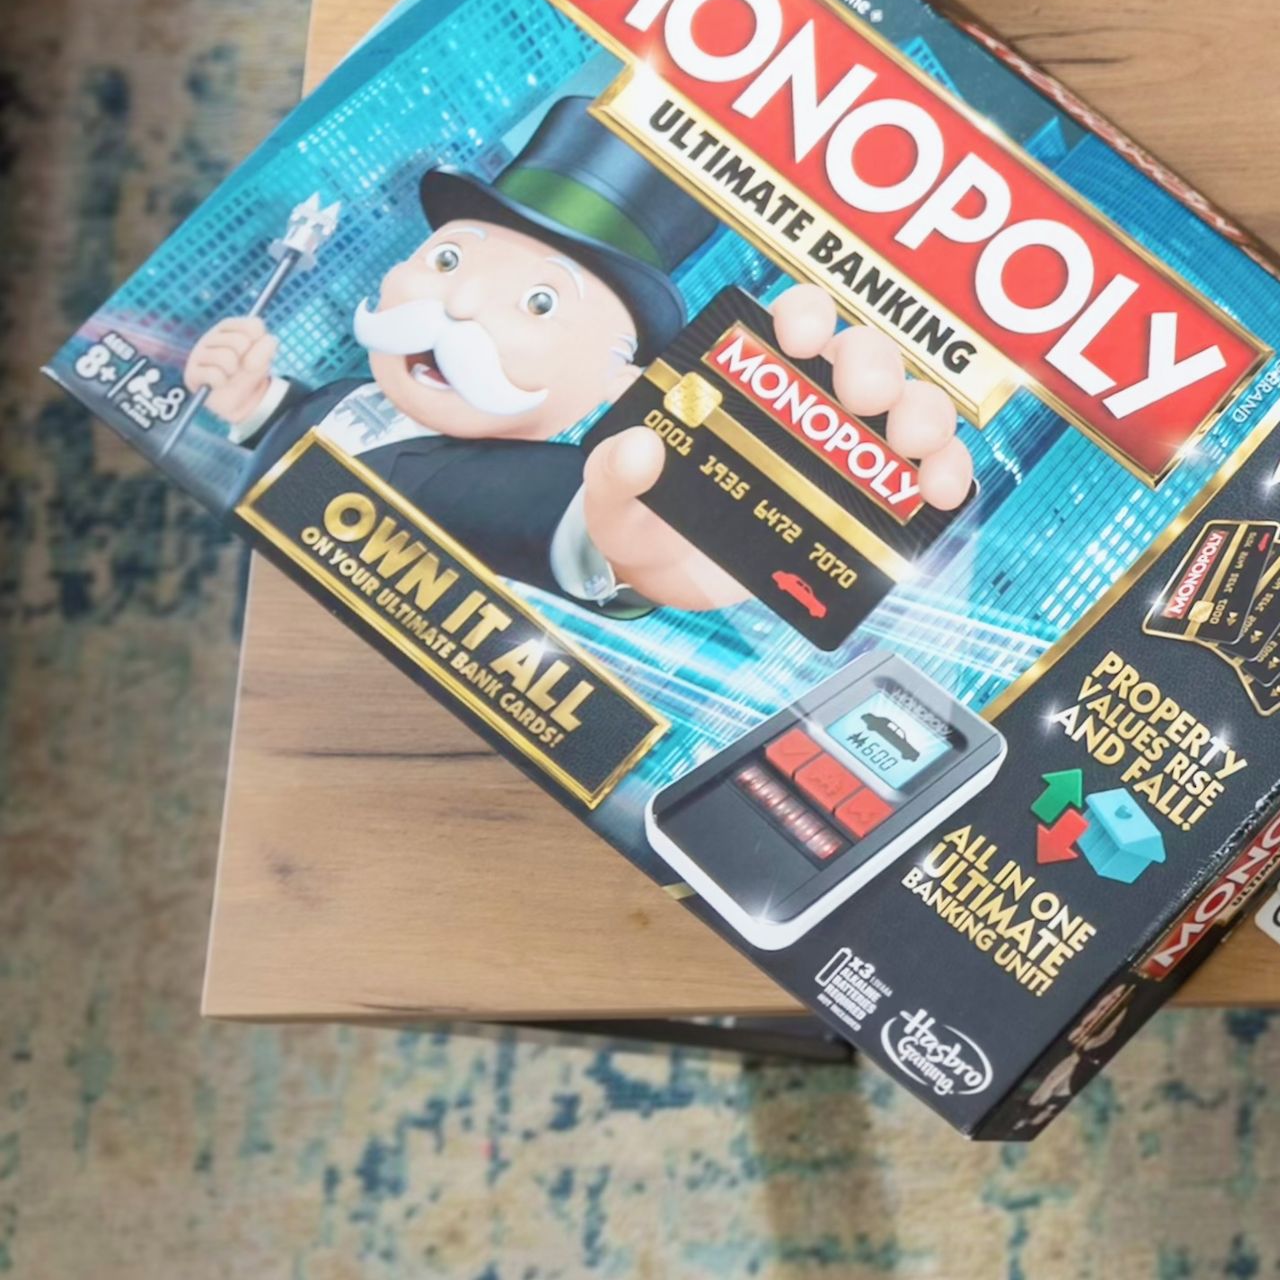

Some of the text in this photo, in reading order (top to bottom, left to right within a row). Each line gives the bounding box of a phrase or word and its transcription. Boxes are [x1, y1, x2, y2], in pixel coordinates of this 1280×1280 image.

[648, 99, 815, 243] ULTIMATE
[807, 228, 980, 378] BANKING
[75, 344, 117, 382] 8+
[715, 335, 921, 505] MONOPOLY
[643, 409, 858, 590] 0001 1935 6472 7070
[301, 526, 565, 748] ON YOUR ULTIMATE BANK CARDS!
[323, 491, 595, 732] OWN IT ALL
[1170, 532, 1224, 615] MONOPOLY
[1053, 705, 1208, 831] AND FALL!
[1077, 676, 1225, 807] VALUES RISE
[1091, 650, 1248, 780] PROPERTY
[901, 866, 1054, 997] BANKING UNIT!
[922, 841, 1075, 978] ULTIMATE
[943, 824, 1097, 952] ALL IN ONE
[831, 974, 878, 1015] BATTERIES
[848, 955, 876, 980] x3
[899, 1008, 983, 1087] Hasbro
